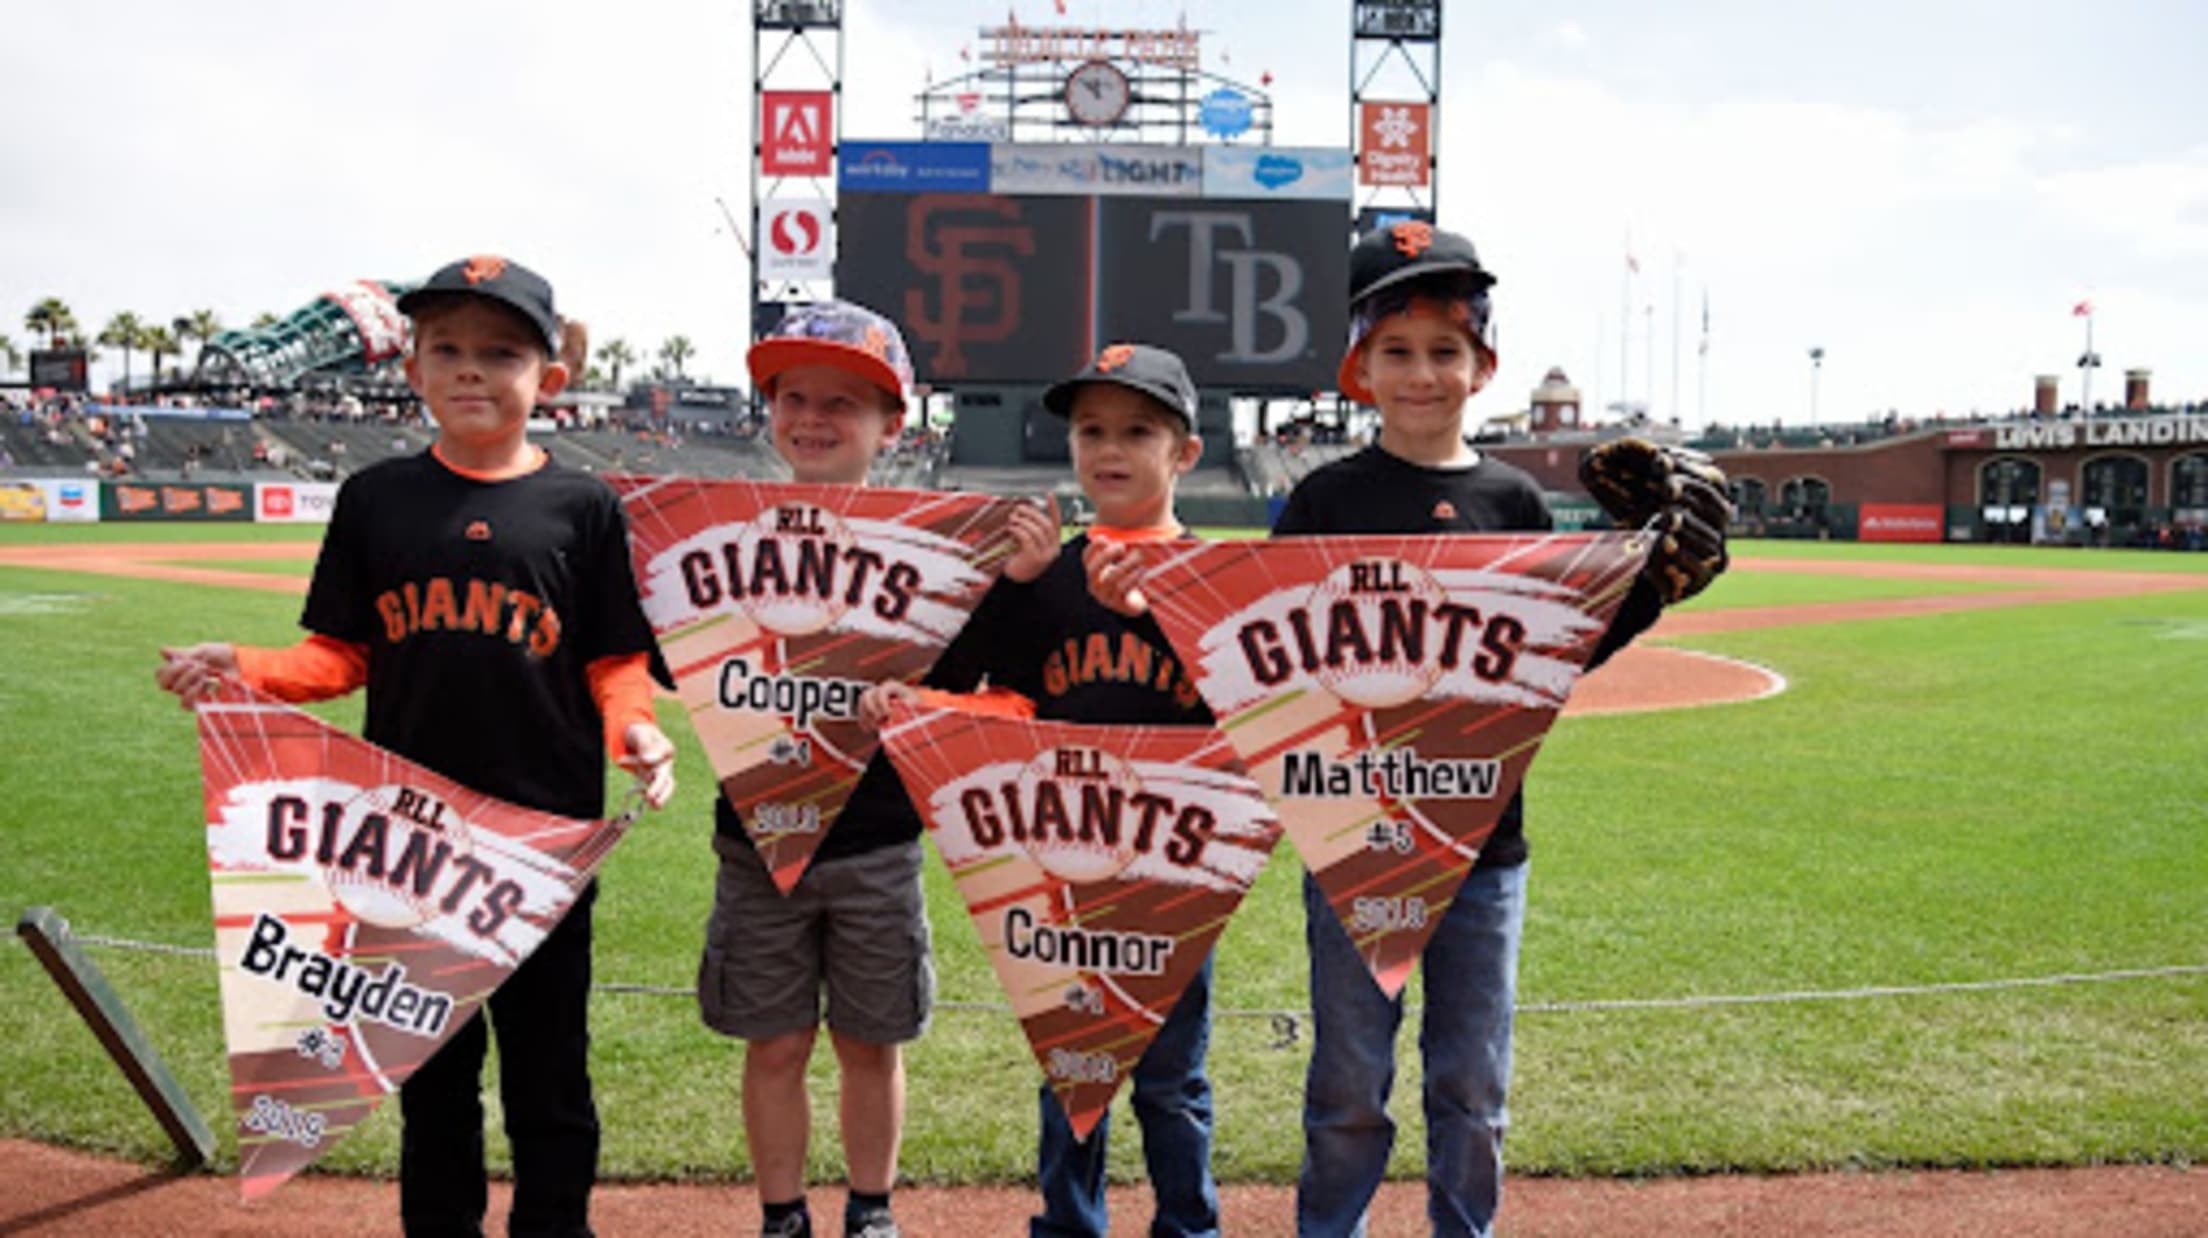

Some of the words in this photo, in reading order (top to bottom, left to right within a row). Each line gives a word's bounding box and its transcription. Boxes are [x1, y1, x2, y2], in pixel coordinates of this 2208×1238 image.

[776, 508, 825, 536] RLL
[680, 538, 920, 622] GIANTS
[1349, 563, 1411, 593] RLL
[375, 577, 561, 656] GIANTS
[1238, 599, 1526, 686] GIANTS
[719, 658, 862, 729] Cooper
[1056, 749, 1109, 779] RLL
[1282, 752, 1498, 797] Matthew
[392, 787, 446, 831] RLL
[960, 779, 1216, 867] GIANTS
[265, 796, 525, 936] GIANTS
[241, 914, 450, 1034] Brayden
[1005, 909, 1173, 970] Connor
